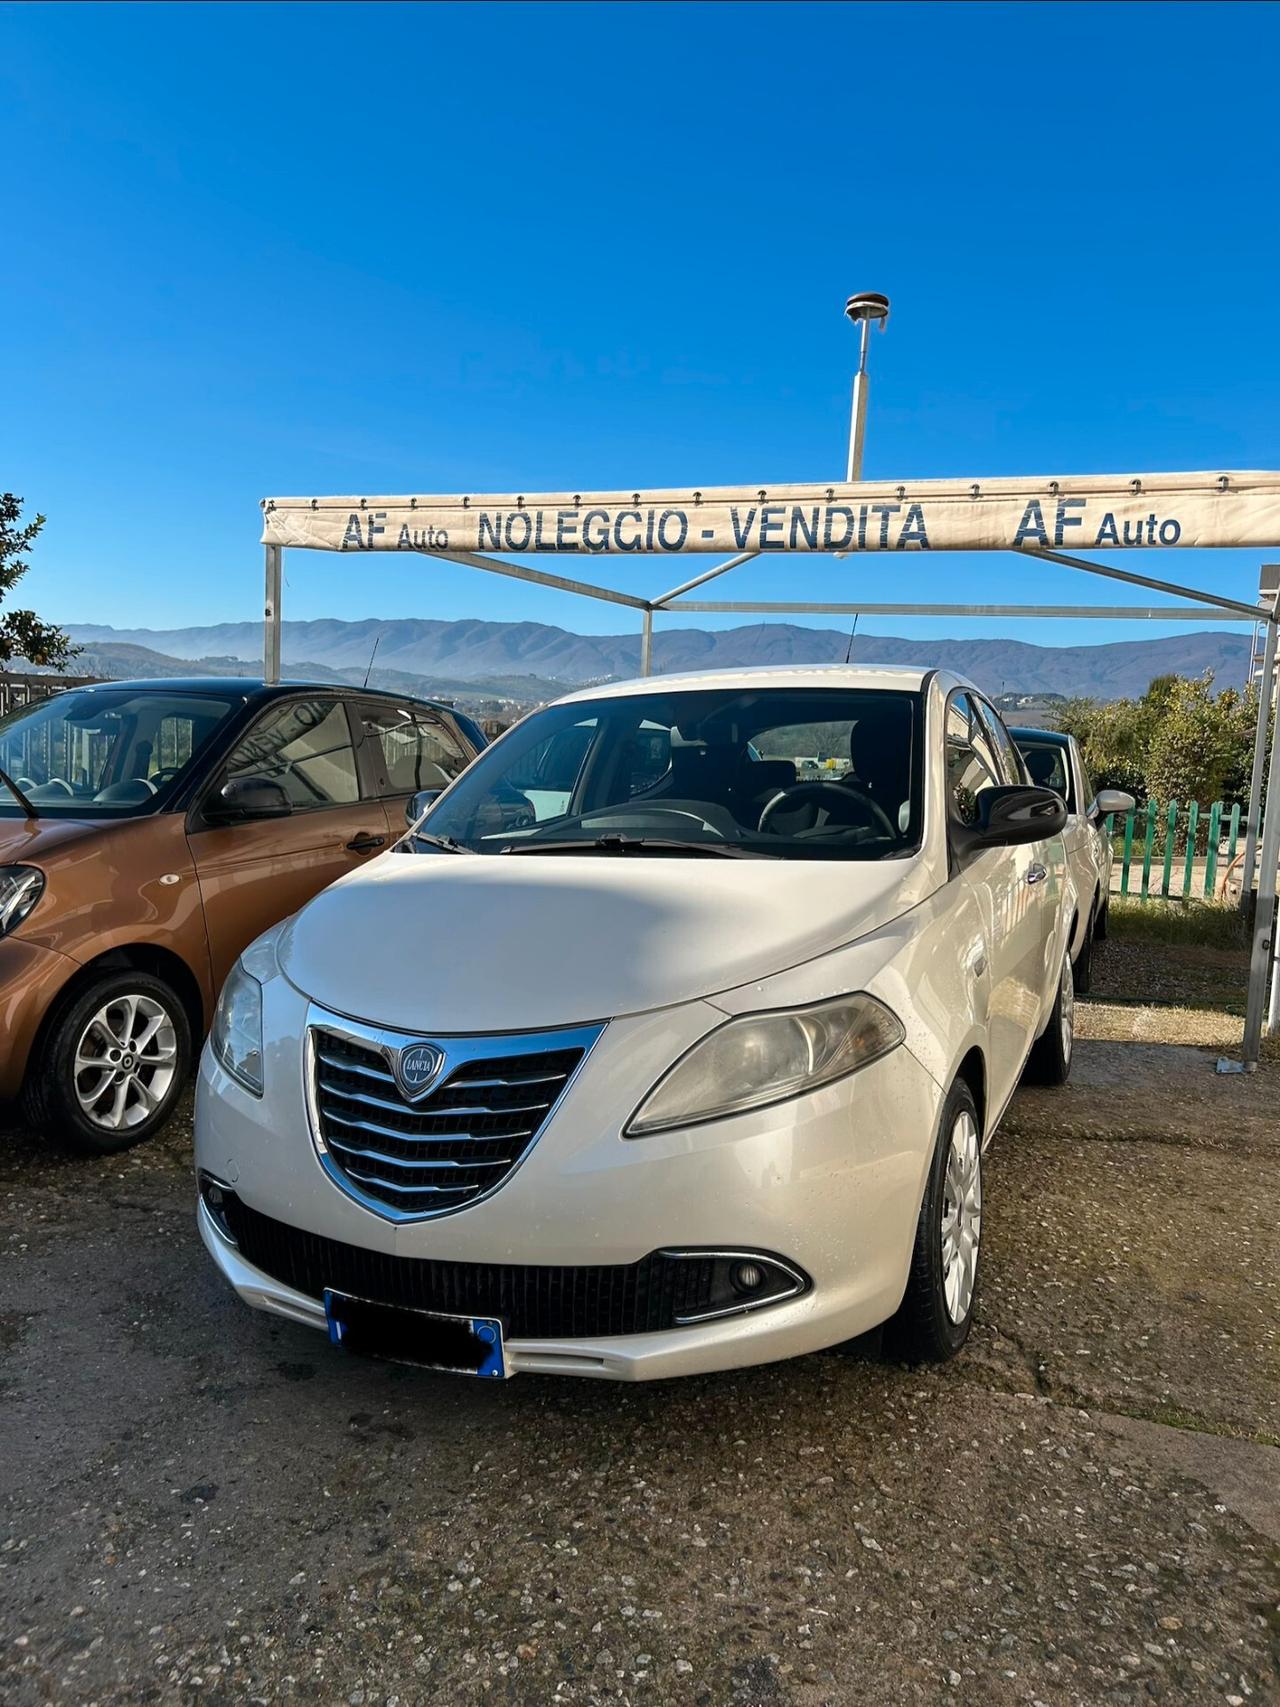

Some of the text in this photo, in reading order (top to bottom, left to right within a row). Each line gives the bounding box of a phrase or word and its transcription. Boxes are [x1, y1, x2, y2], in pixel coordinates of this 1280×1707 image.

[342, 513, 387, 549] AF
[398, 523, 448, 549] Auto
[478, 509, 689, 551] NOLEGGIO
[730, 503, 930, 550] VENDITA
[1013, 498, 1087, 546] AF
[1095, 512, 1181, 546] Auto
[406, 1059, 431, 1072] LANCIA
